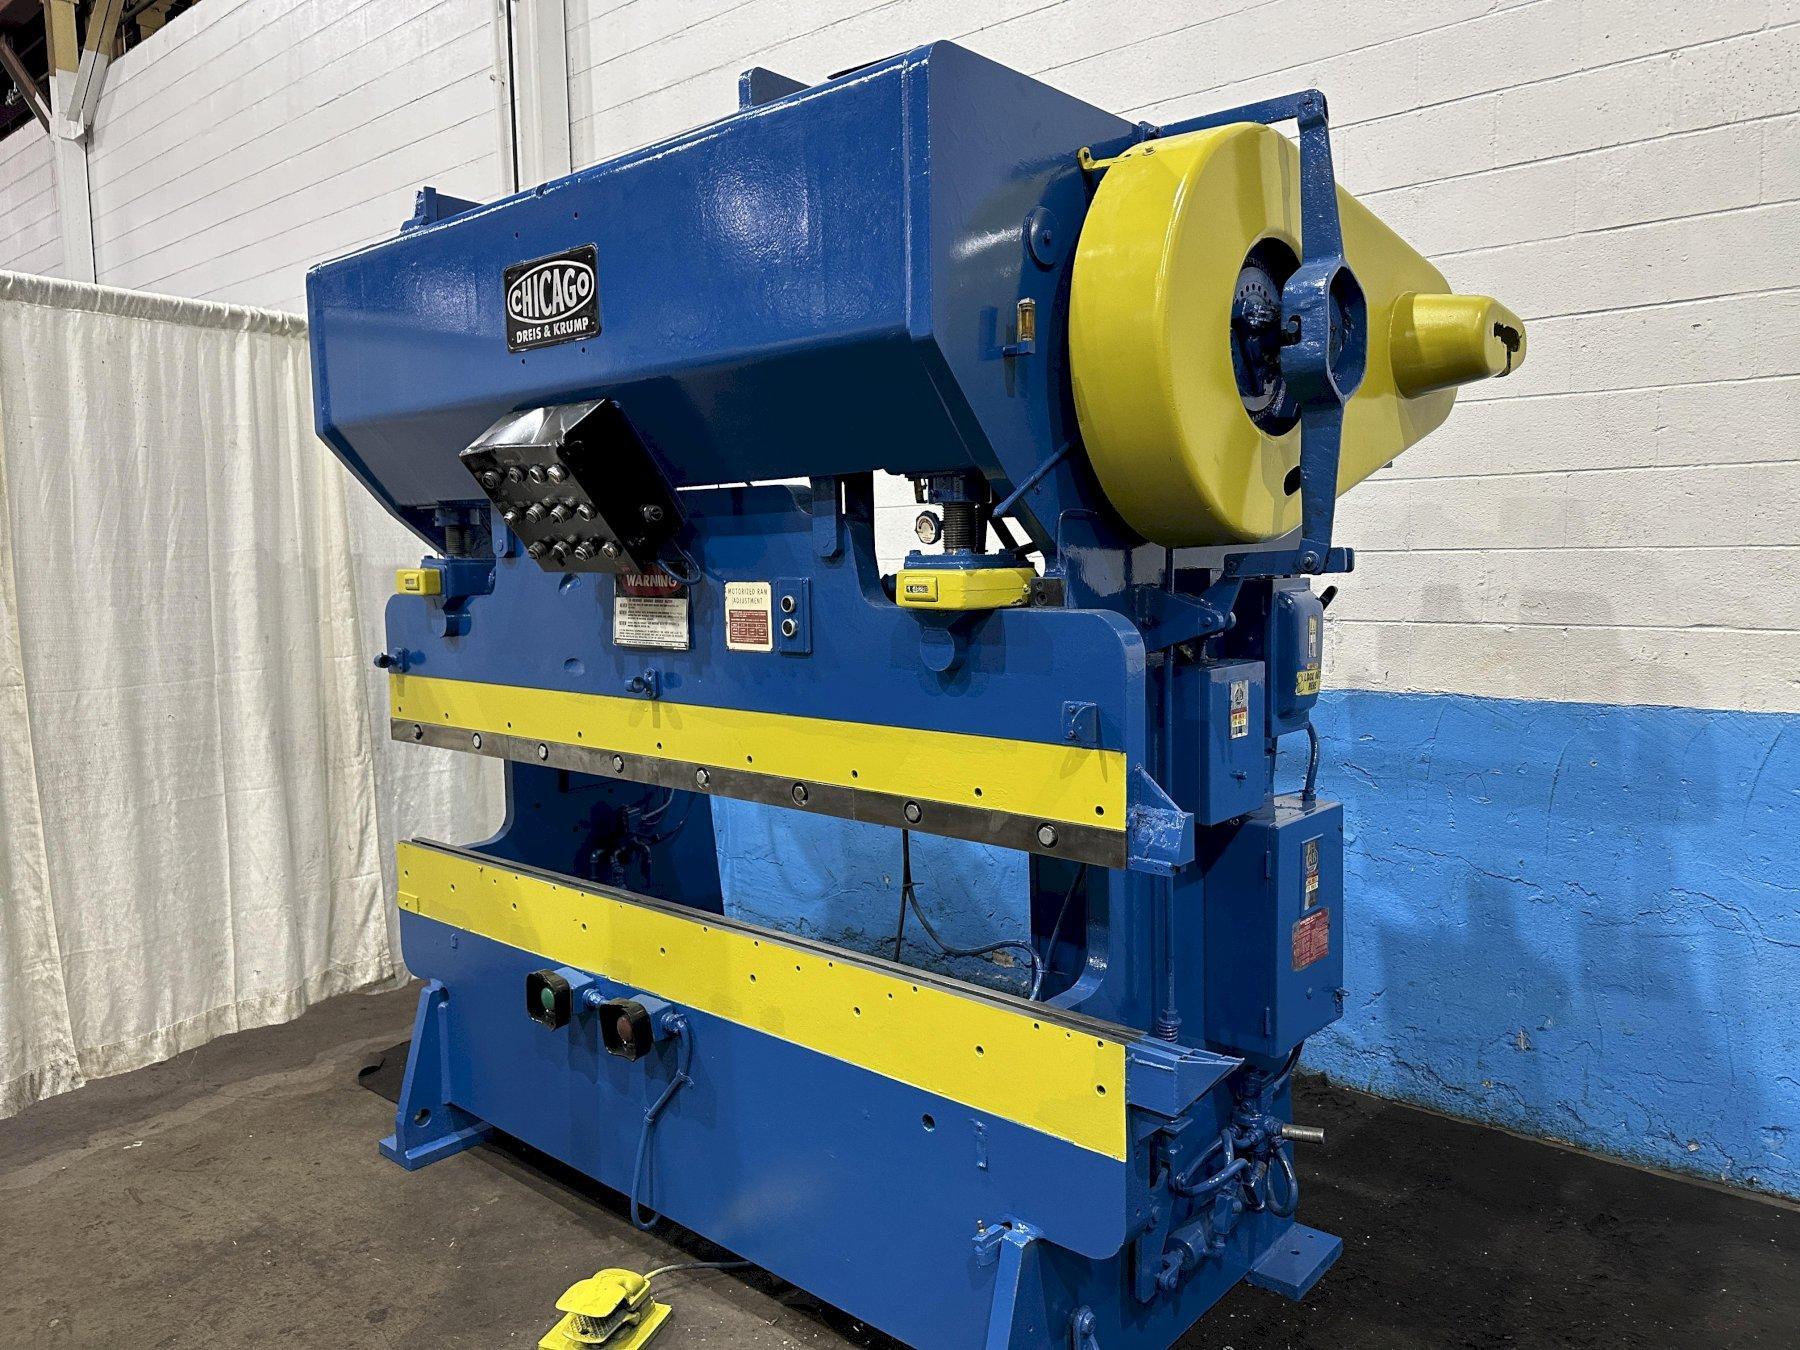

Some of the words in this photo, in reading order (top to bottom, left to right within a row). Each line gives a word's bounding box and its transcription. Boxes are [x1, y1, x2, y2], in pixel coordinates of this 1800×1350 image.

[511, 268, 590, 317] CHICAGO
[516, 327, 542, 343] DREIS
[543, 325, 551, 338] &
[553, 317, 589, 335] KRUMP
[733, 597, 763, 605] ADJUSTMENT
